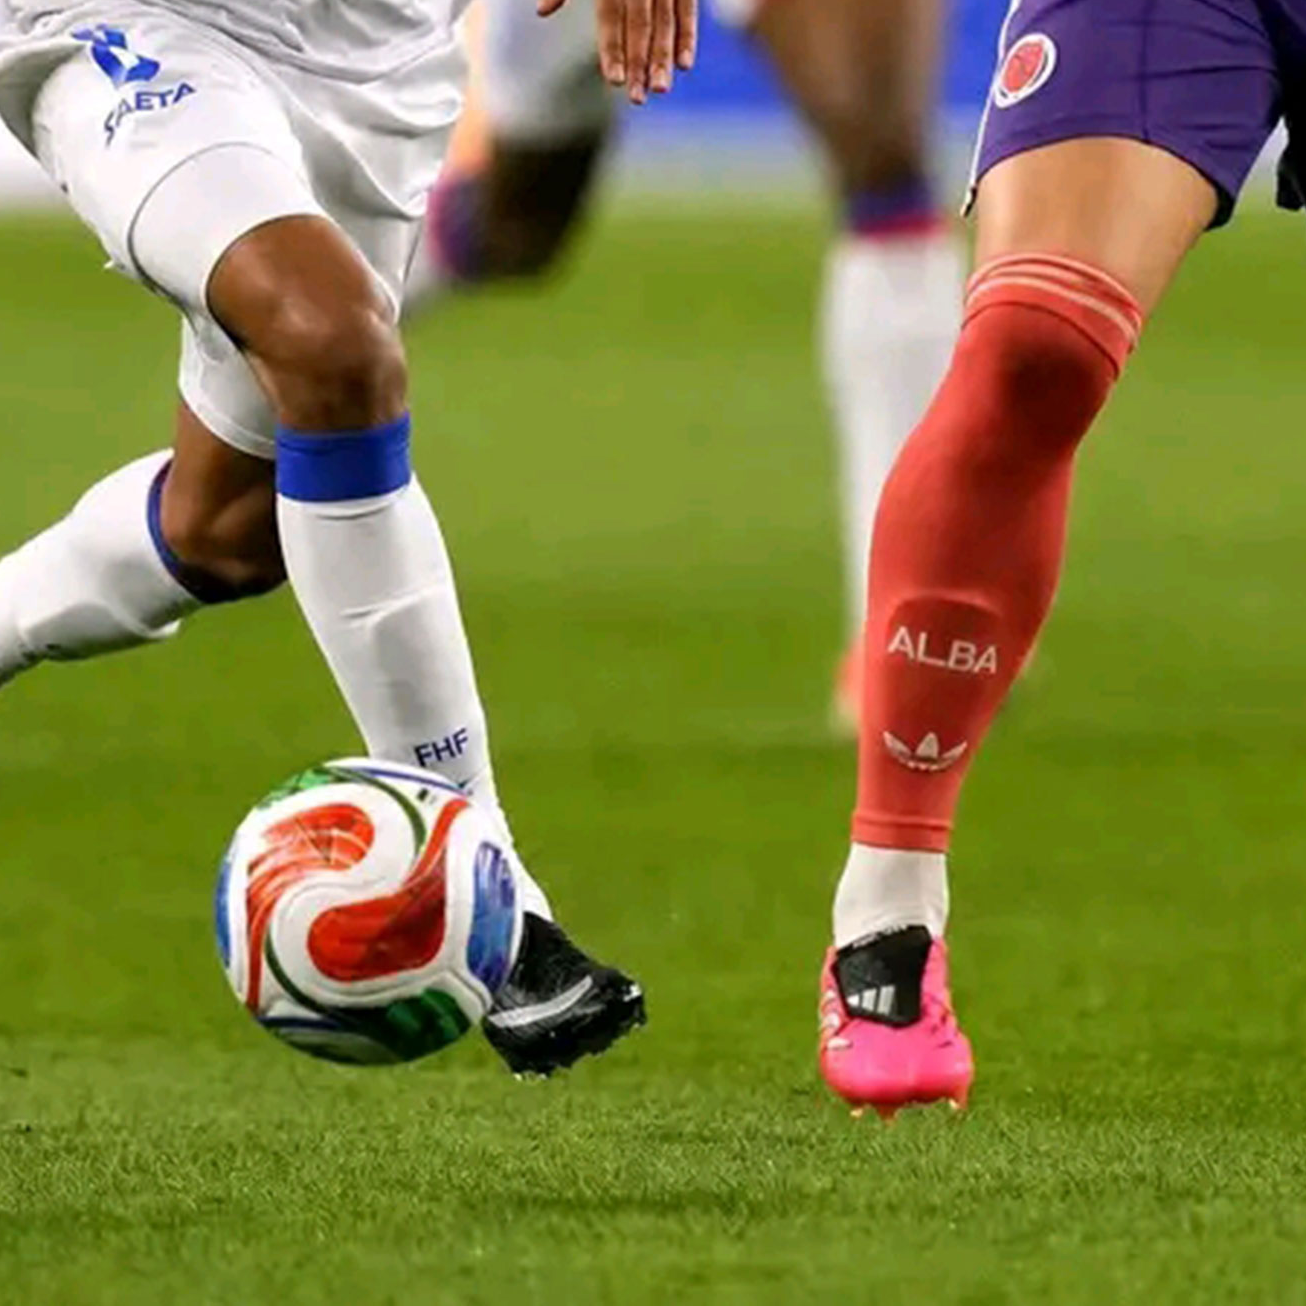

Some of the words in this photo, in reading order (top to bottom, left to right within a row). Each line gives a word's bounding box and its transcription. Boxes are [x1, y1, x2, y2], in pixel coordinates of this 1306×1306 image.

[104, 82, 196, 148] SAETA
[887, 626, 998, 674] ALBA
[414, 727, 468, 768] FHF
